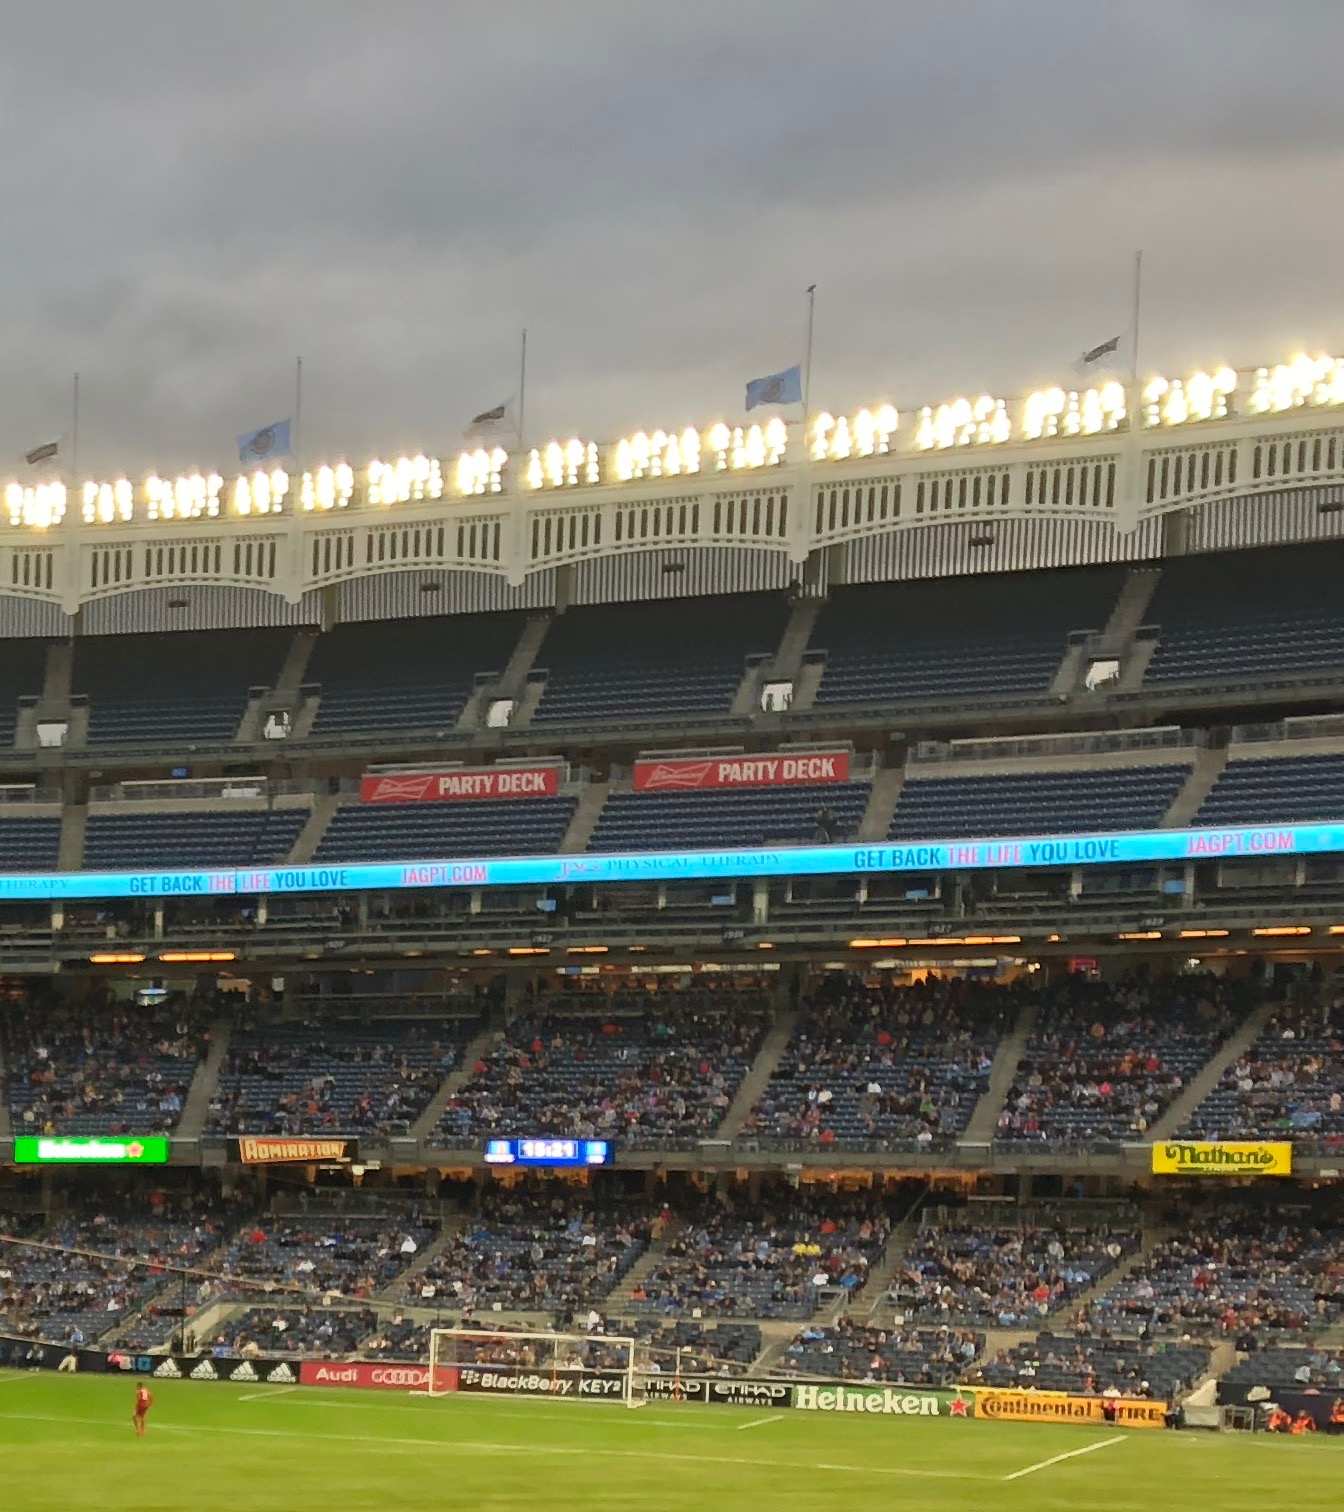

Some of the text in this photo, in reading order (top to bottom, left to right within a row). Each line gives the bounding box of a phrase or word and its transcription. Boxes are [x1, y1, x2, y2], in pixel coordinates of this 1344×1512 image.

[717, 760, 778, 782] PARTY
[782, 757, 835, 780] DECK
[438, 775, 494, 796] PARTY
[498, 773, 546, 793] DECK
[854, 849, 889, 869] GET
[892, 848, 941, 867] BACK
[947, 847, 979, 865] THE
[986, 845, 1022, 863] LIFE
[1029, 842, 1068, 861] YOU
[1074, 839, 1120, 860] LOVE
[129, 877, 157, 893] GET
[161, 876, 203, 892] BACK
[208, 875, 235, 891] THE
[242, 873, 271, 890] LIFE
[274, 871, 308, 889] YOU
[311, 870, 348, 887] LOVE
[315, 1367, 358, 1382] Audi
[481, 1373, 573, 1395] BlackBerry
[796, 1385, 940, 1416] Heineken
[980, 1394, 1093, 1418] Continental
